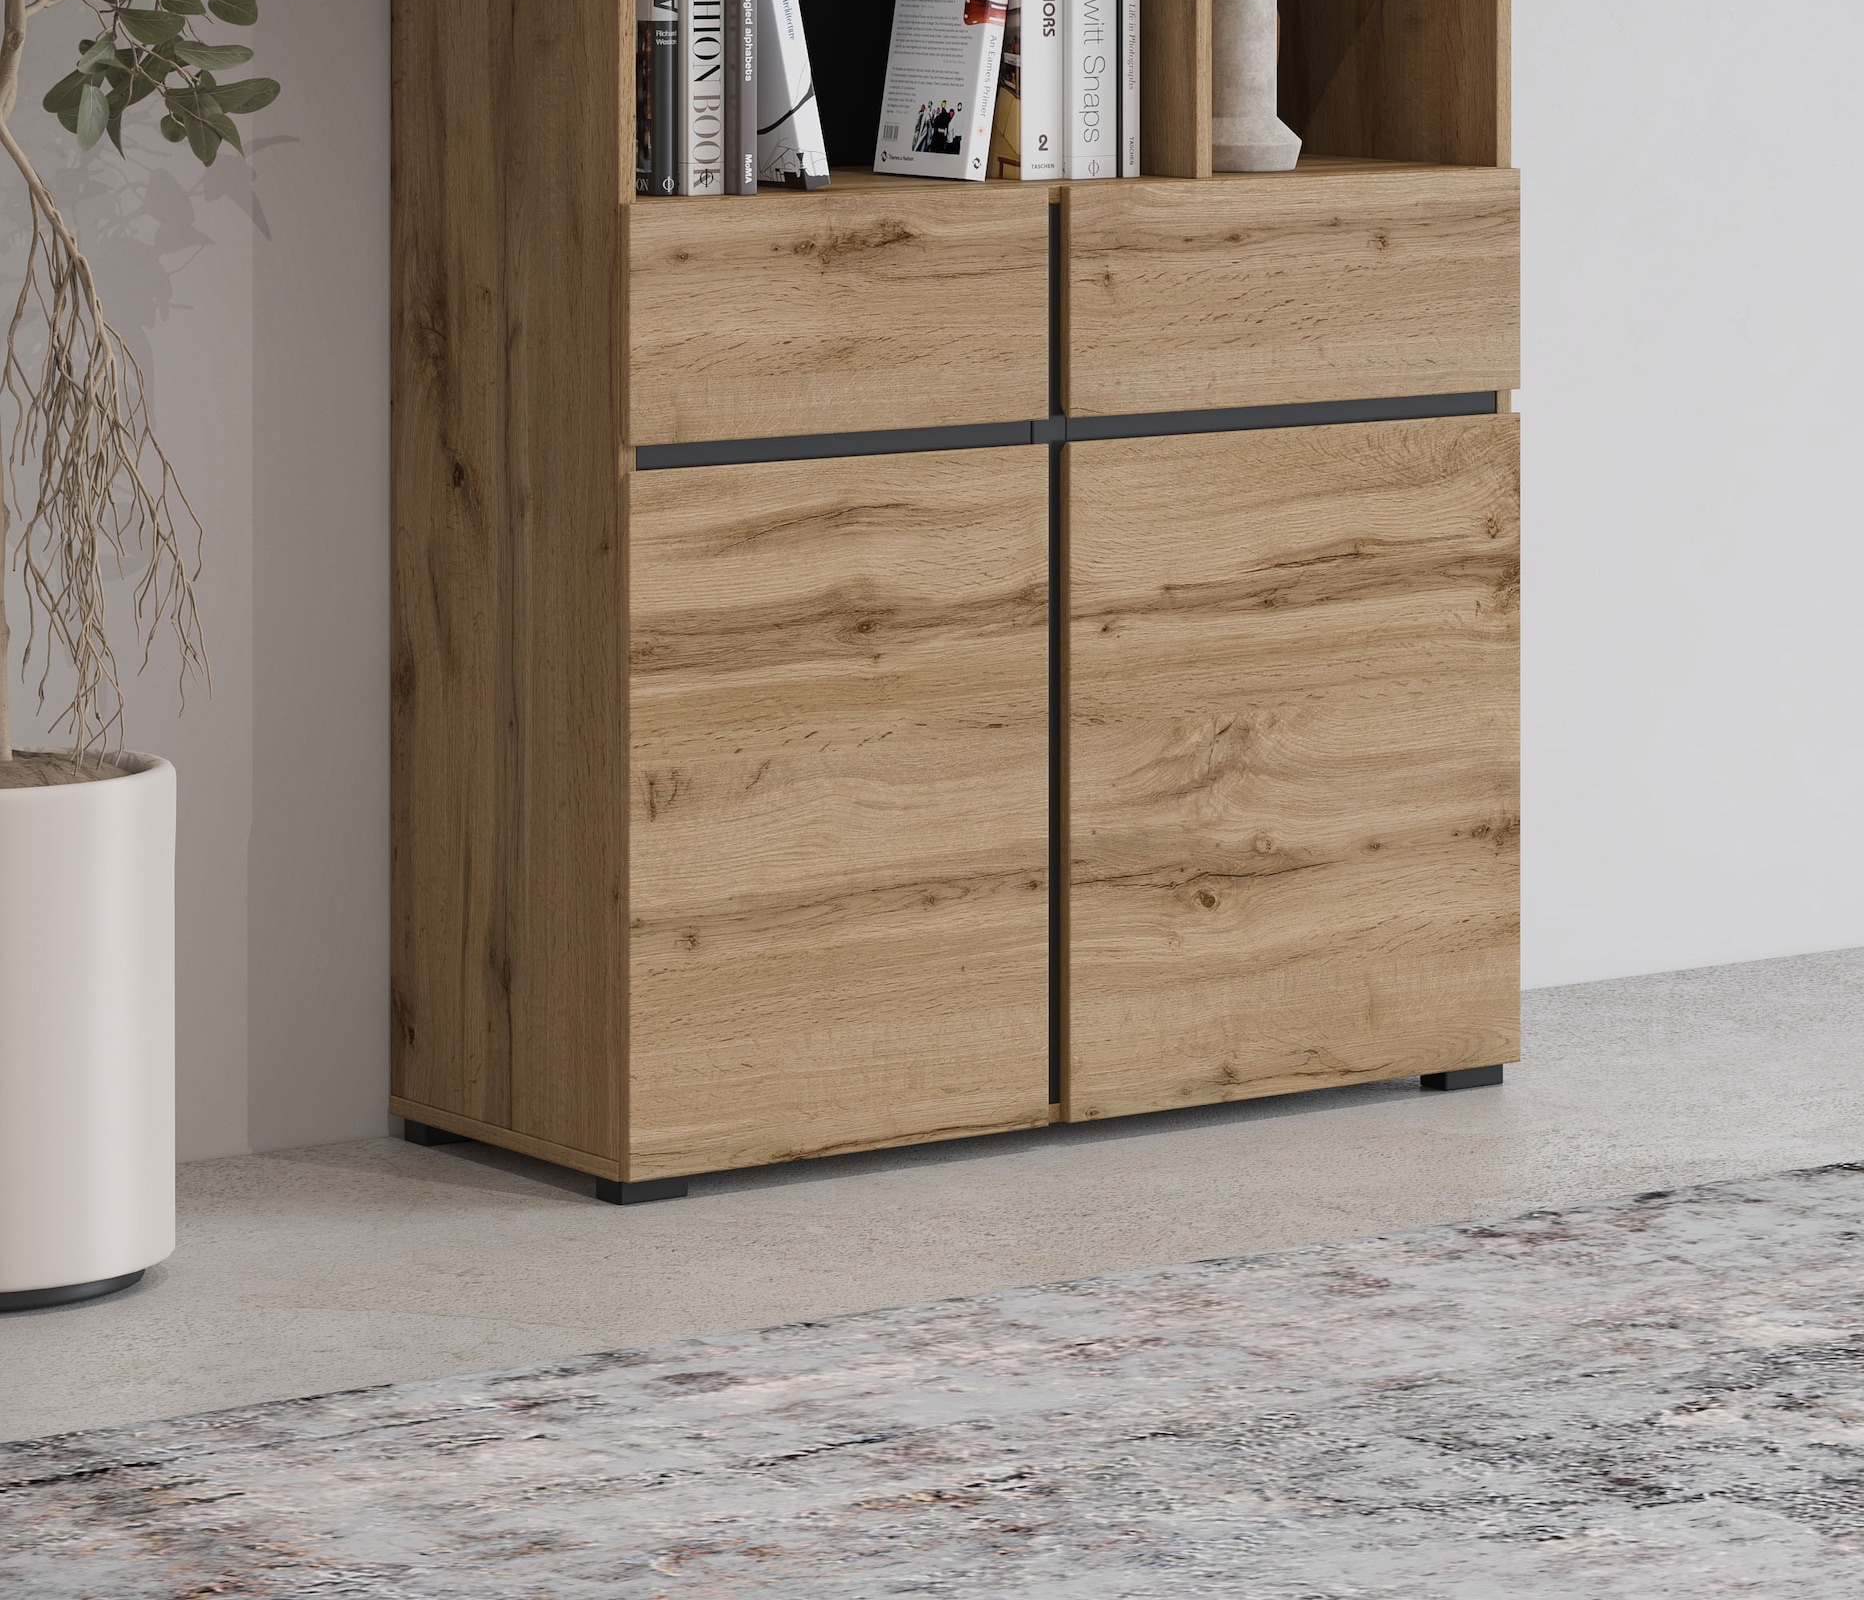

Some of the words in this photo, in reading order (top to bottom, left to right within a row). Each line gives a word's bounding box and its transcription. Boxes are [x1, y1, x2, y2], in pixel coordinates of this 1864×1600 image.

[1128, 3, 1137, 21] Life
[1128, 22, 1136, 32] in
[743, 27, 753, 82] alphabets
[990, 34, 998, 48] An
[984, 51, 996, 84] Eames
[1127, 34, 1137, 90] Photographs
[980, 86, 992, 117] Primer
[1078, 55, 1106, 143] Snaps
[693, 94, 721, 188] BOOK
[1038, 134, 1049, 152] 2
[744, 153, 753, 184] MoMA
